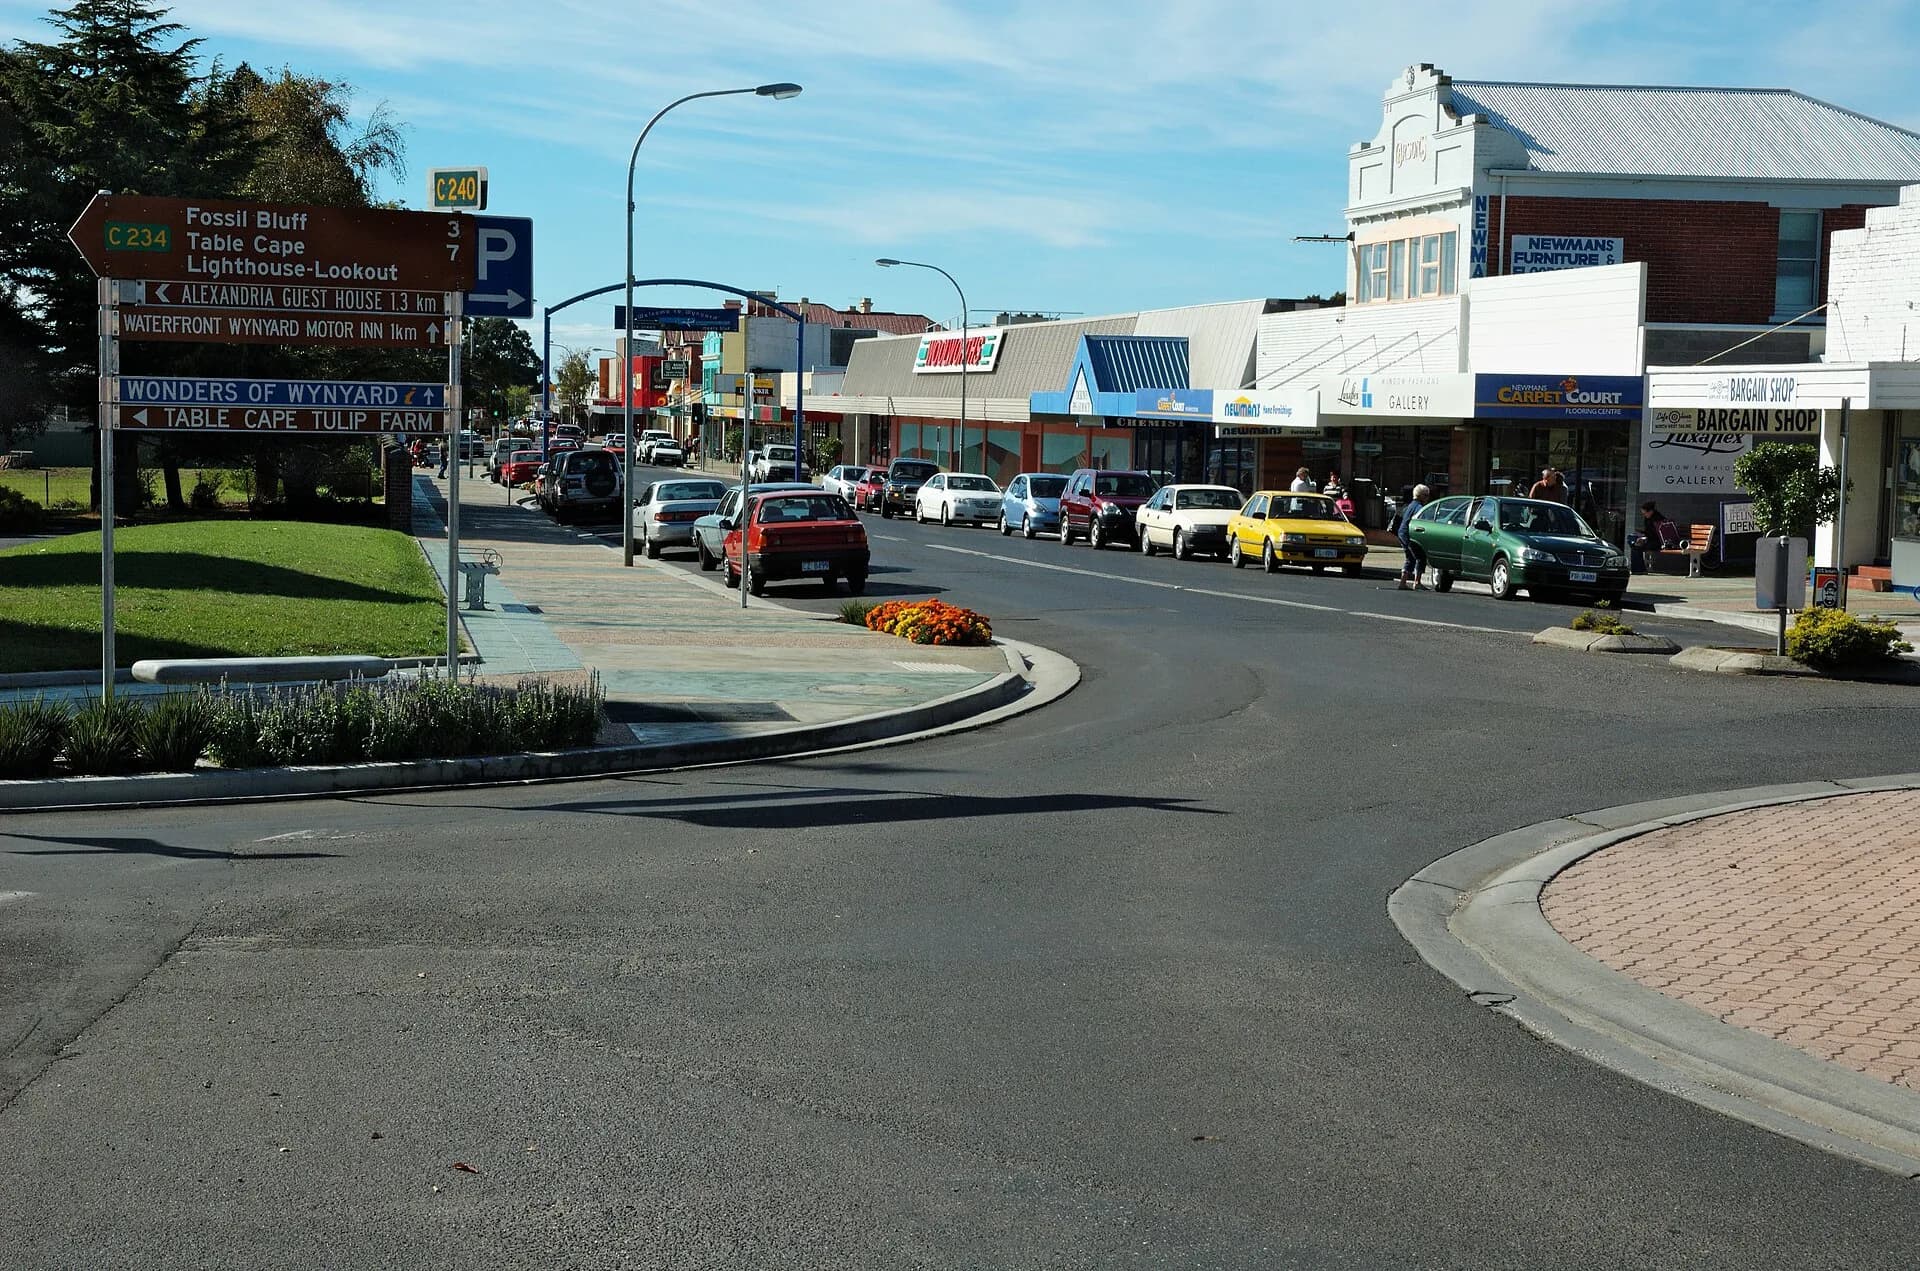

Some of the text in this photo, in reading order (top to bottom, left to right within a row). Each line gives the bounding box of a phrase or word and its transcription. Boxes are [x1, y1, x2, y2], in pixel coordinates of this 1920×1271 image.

[437, 177, 475, 200] C 240
[186, 207, 460, 238] Fossil Bluff 3
[108, 226, 167, 248] C 234
[186, 231, 460, 261] Table Cape 7
[1528, 238, 1614, 251] NEWMANS
[478, 227, 517, 281] P
[1513, 251, 1599, 266] FURNITURE
[187, 254, 399, 281] Lighthouse-Lookout
[182, 284, 437, 312] ALEXANDRIA GUEST HOUSE 1.3 km
[123, 314, 417, 341] WATERFRONT WYNYARD MOTOR INN 1km
[127, 380, 239, 402] WONDERS
[248, 383, 277, 402] OF
[287, 384, 398, 406] WYNYARD
[1497, 387, 1622, 404] CARPET COURT
[1730, 378, 1768, 402] BARGAIN
[1770, 377, 1795, 402] SHOP
[1389, 395, 1429, 410] GALLERY
[164, 407, 433, 431] TABLE CAPE TULIP FARM
[1697, 409, 1769, 431] BARGAIN
[1774, 409, 1818, 432] SHOP
[1665, 475, 1725, 485] GALLERY
[1730, 521, 1754, 532] OPEN
